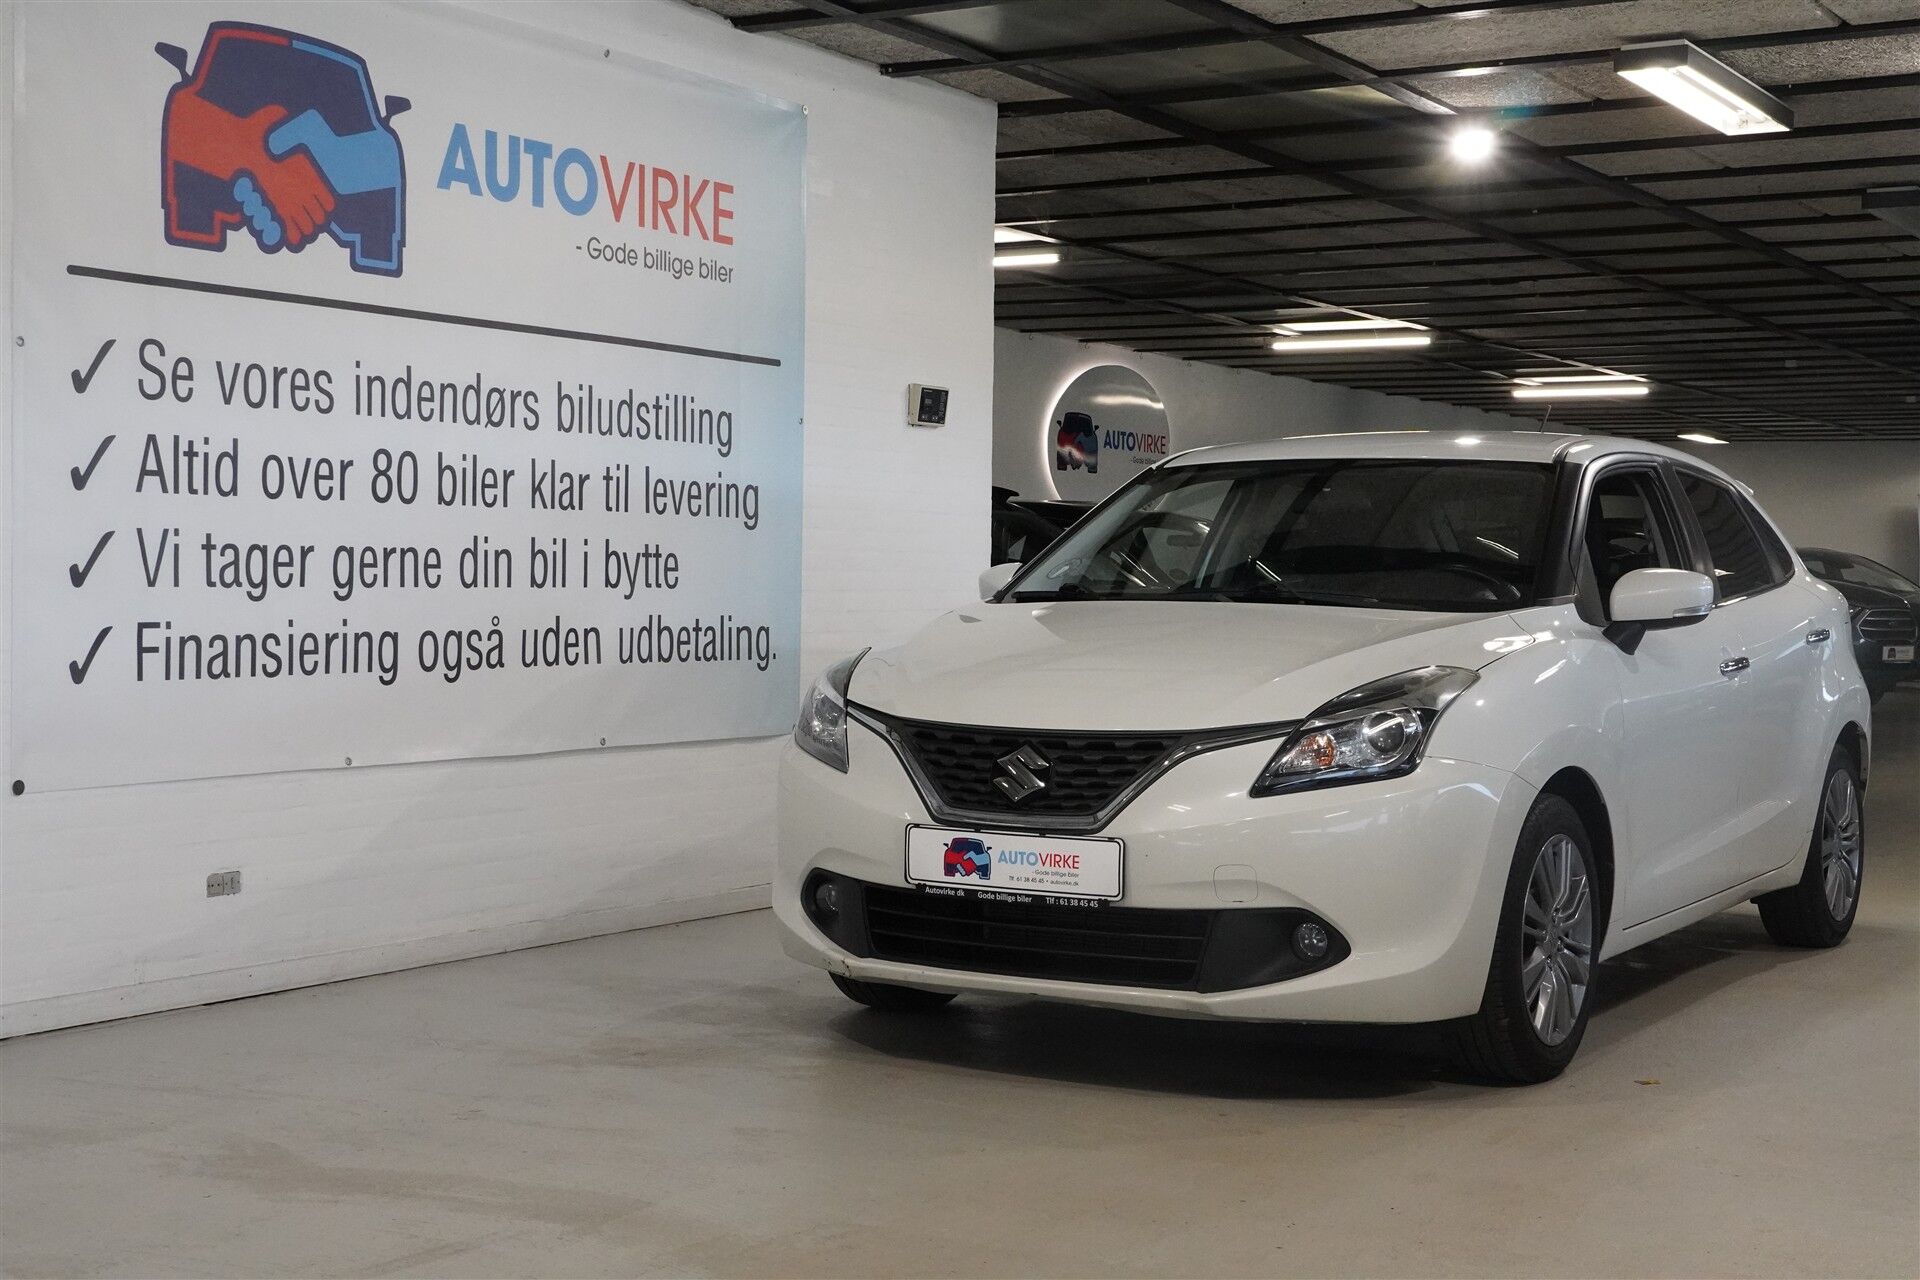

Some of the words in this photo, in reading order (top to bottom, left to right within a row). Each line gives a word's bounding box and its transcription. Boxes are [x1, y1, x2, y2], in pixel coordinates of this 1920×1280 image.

[437, 122, 734, 246] AUTOVIRKE
[586, 236, 638, 266] Gode
[643, 246, 694, 279] billige
[699, 257, 733, 283] biler
[138, 338, 194, 403] Se
[215, 360, 335, 415] vores
[355, 361, 540, 431] indendørs
[557, 381, 732, 458] biludstilling
[1103, 429, 1166, 454] AUTOVIRKE
[135, 433, 239, 498] Altid
[261, 454, 354, 501] over
[371, 448, 419, 505] 80
[437, 451, 515, 508] biler
[531, 458, 591, 511] klar
[602, 464, 630, 513] til
[645, 465, 759, 531] levering
[136, 527, 180, 588] Vi
[201, 532, 315, 602] tager
[332, 545, 442, 602] gerne
[459, 535, 512, 589] din
[530, 536, 567, 589] bil
[583, 538, 589, 589] i
[604, 538, 679, 601] bytte
[136, 619, 399, 687] Finansiering
[418, 615, 505, 684] også
[521, 615, 602, 668] uden
[618, 614, 778, 672] udbetaling.
[998, 850, 1080, 869] AUTOVIRKE
[977, 891, 995, 900] Gode
[996, 893, 1016, 903] billige
[1017, 895, 1033, 903] biler
[1059, 898, 1068, 906] 61
[1069, 898, 1079, 907] 38
[1079, 899, 1089, 907] 45
[1089, 900, 1099, 908] 45
